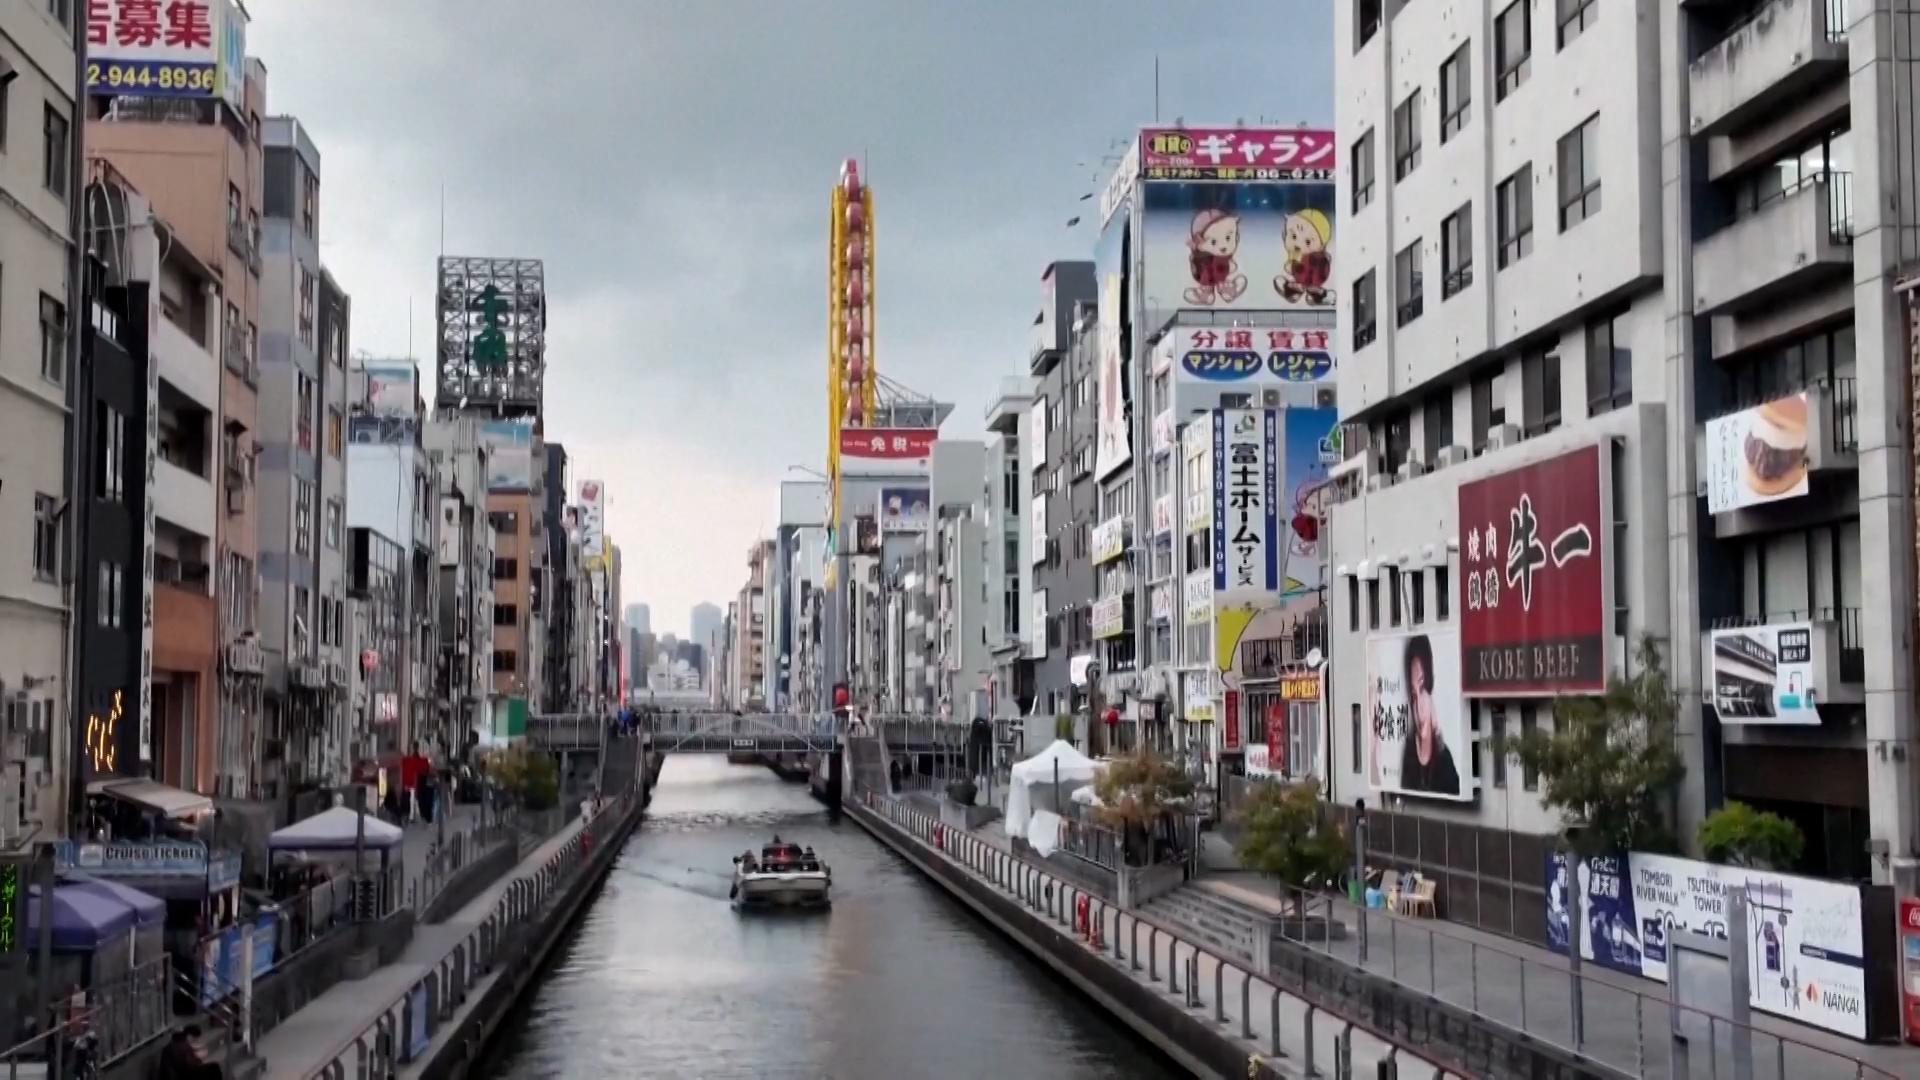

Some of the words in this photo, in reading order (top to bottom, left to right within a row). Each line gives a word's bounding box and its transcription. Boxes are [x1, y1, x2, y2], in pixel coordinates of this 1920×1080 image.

[87, 65, 215, 89] 2-944-8936
[1196, 133, 1333, 164] ギャラン
[1188, 354, 1258, 370] マンション
[1479, 649, 1526, 680] KOBE
[1533, 644, 1580, 678] BEEF
[1640, 868, 1673, 887] TOMBORI
[1636, 887, 1658, 901] RIVER
[1658, 889, 1679, 906] WALK
[1694, 895, 1722, 915] TOWER
[1822, 990, 1859, 1017] NANKAI
